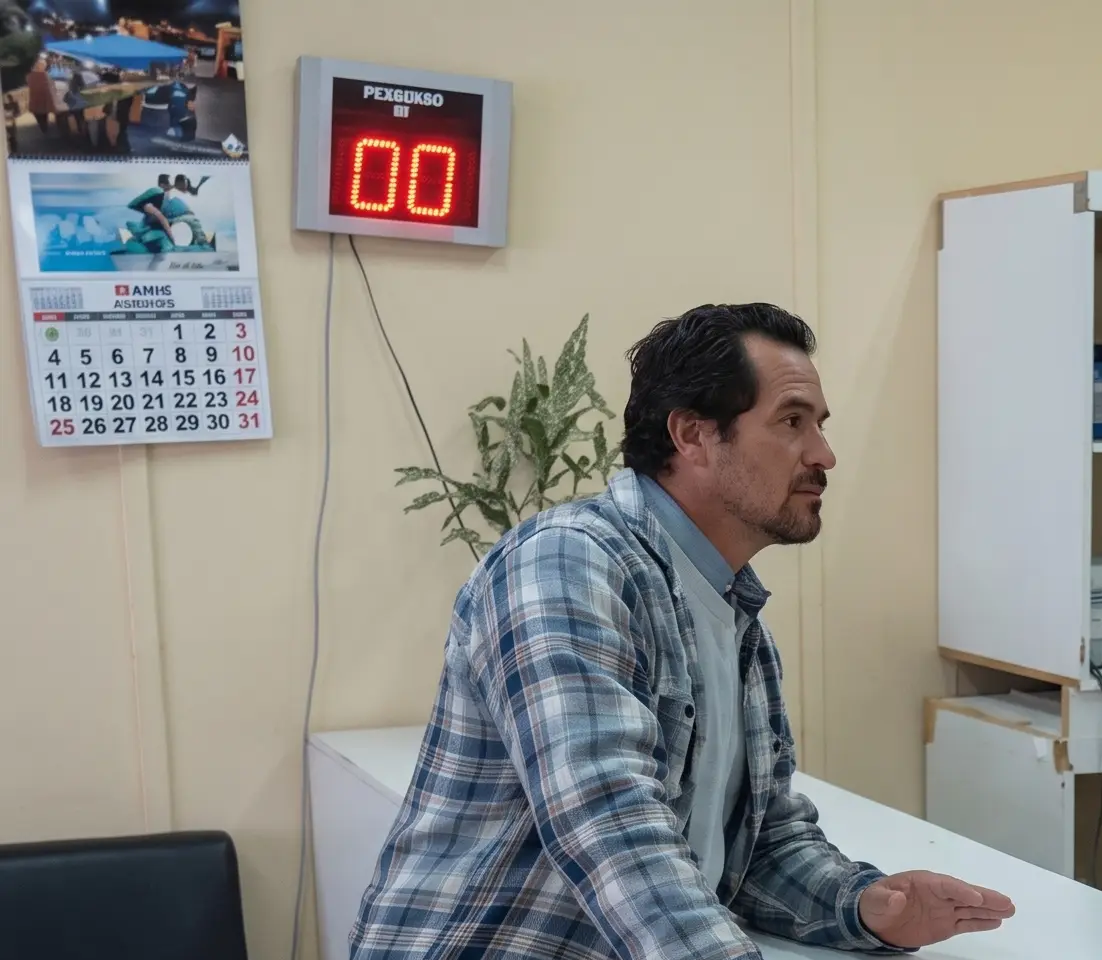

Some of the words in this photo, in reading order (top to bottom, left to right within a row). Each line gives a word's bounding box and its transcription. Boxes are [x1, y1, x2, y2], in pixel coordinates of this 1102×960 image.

[351, 138, 456, 217] 00
[173, 323, 183, 340] 1
[203, 323, 217, 340] 2
[235, 322, 247, 339] 3
[47, 349, 62, 366] 4
[80, 349, 93, 366] 5
[111, 348, 125, 365] 6
[142, 347, 155, 364] 7
[174, 346, 187, 363] 8
[205, 346, 218, 363] 9
[231, 345, 255, 362] 10
[44, 372, 67, 390] 11
[76, 372, 102, 389] 12
[108, 371, 133, 388] 13
[139, 370, 165, 387] 14
[171, 369, 196, 386] 15
[202, 368, 227, 386] 16
[233, 367, 257, 385] 17
[47, 395, 72, 413] 18
[79, 395, 104, 412] 19
[110, 394, 135, 411] 20
[141, 393, 164, 410] 21
[173, 392, 198, 409] 22
[204, 391, 228, 408] 23
[235, 390, 259, 407] 24
[50, 419, 75, 436] 25
[81, 418, 107, 435] 26
[112, 416, 137, 434] 27
[144, 415, 169, 433] 28
[175, 414, 200, 432] 29
[206, 413, 230, 430] 30
[238, 412, 260, 429] 31
